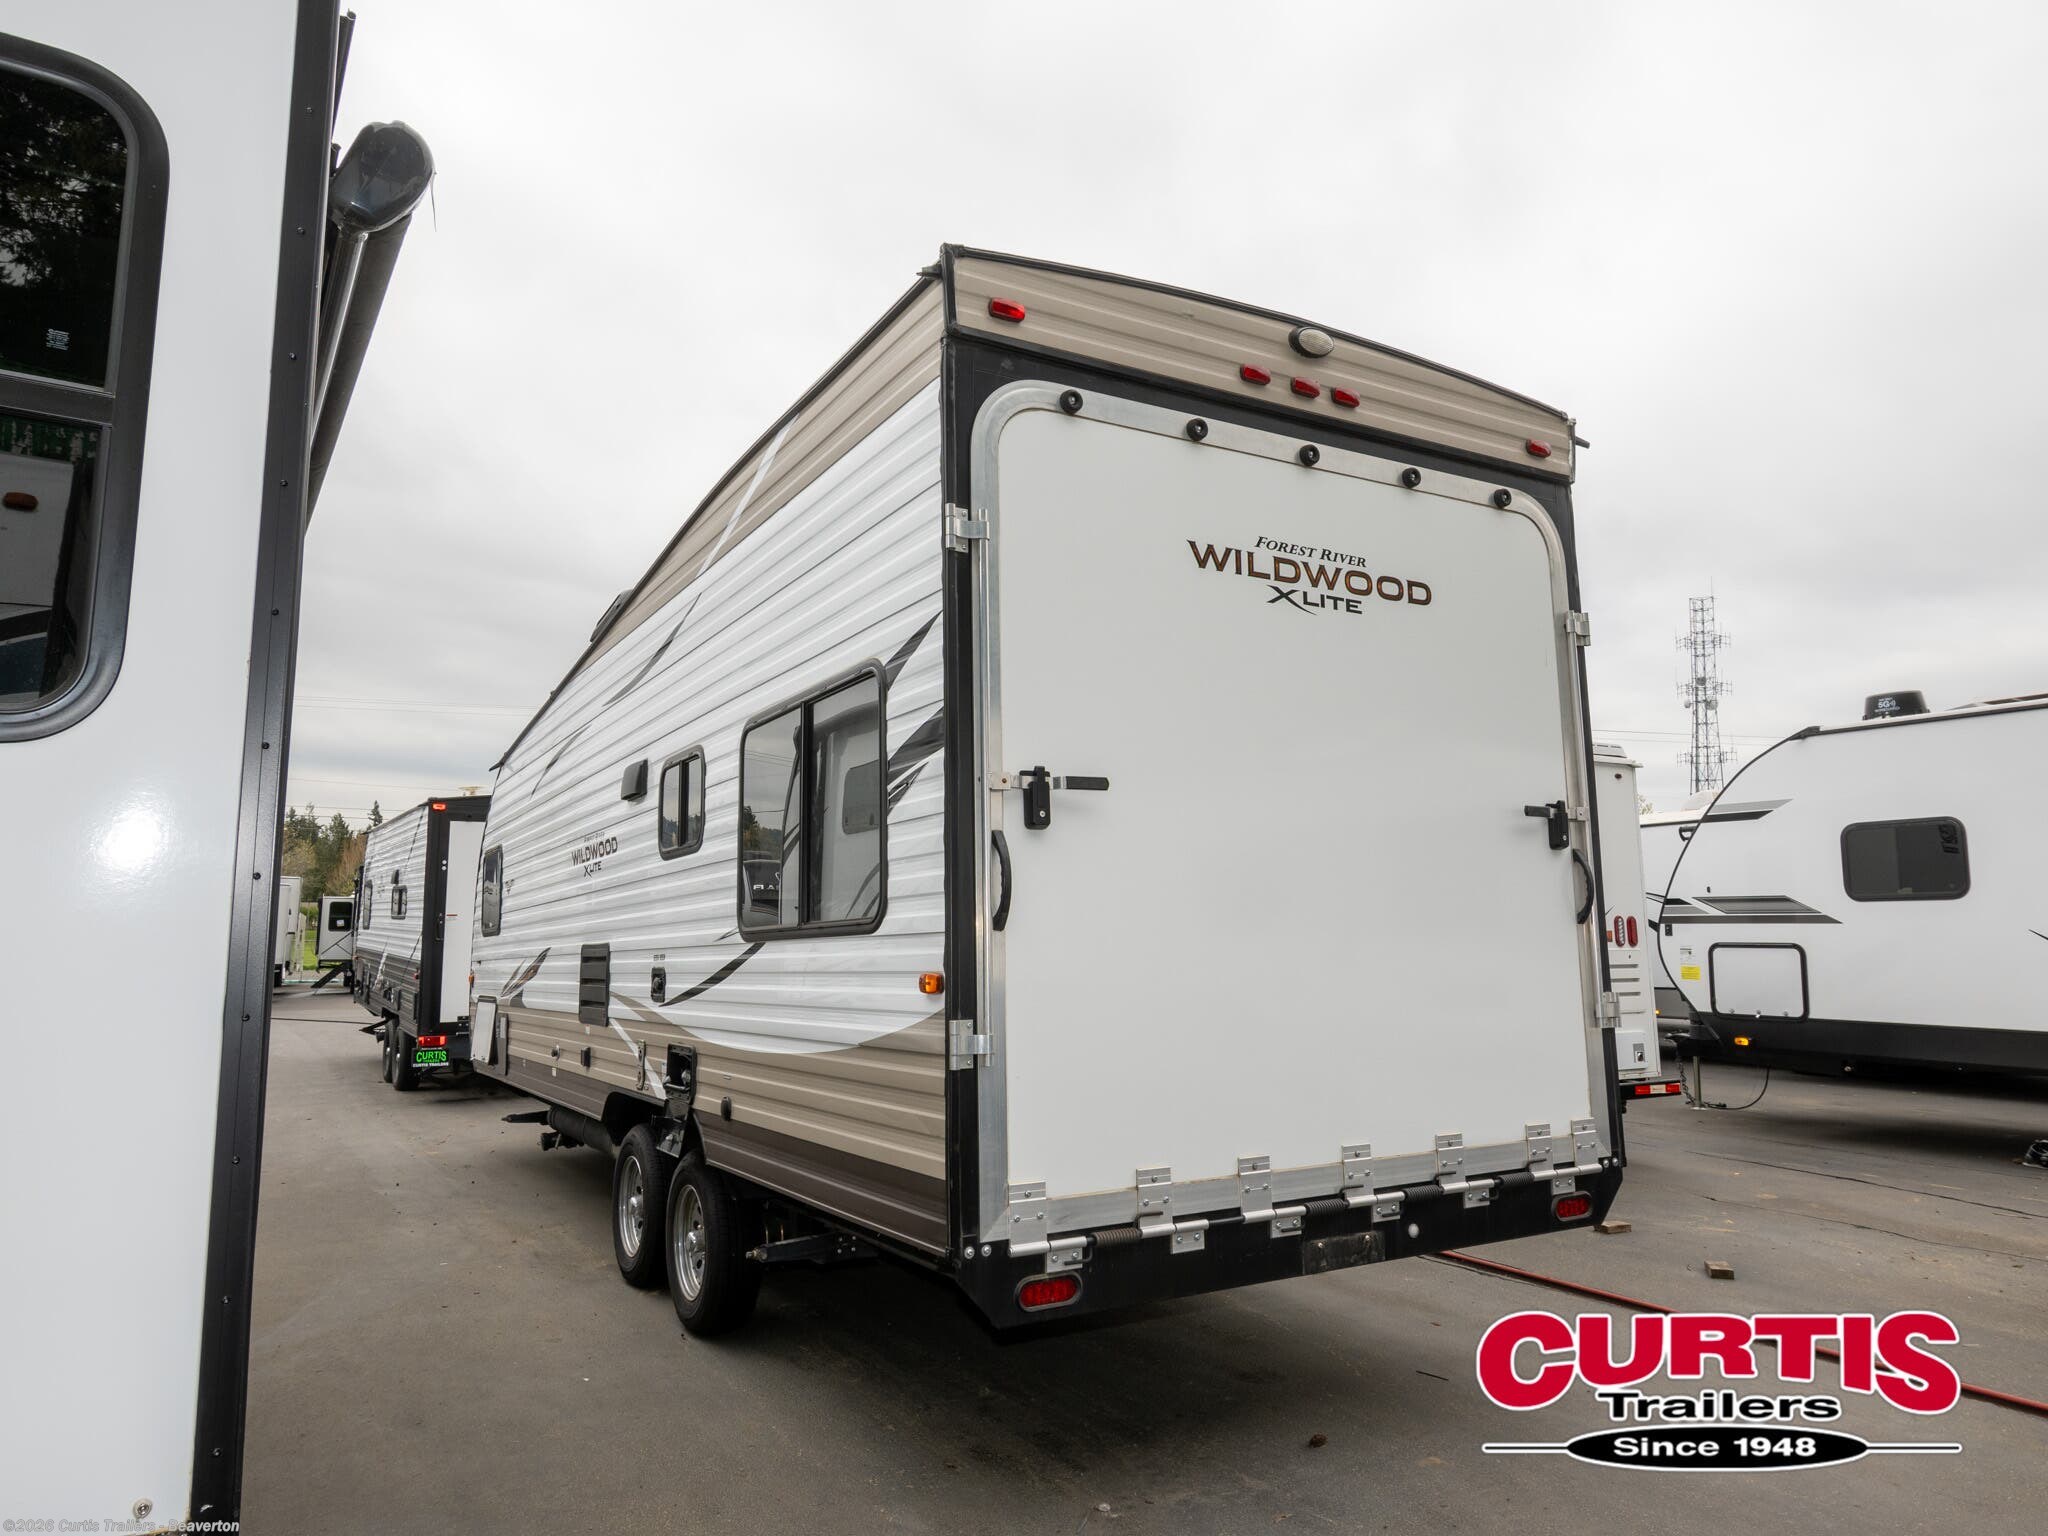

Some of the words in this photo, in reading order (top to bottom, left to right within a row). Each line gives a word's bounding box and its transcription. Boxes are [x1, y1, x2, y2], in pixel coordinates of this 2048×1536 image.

[1255, 536, 1317, 558] FOREST
[1320, 548, 1367, 568] RIVER
[1186, 539, 1432, 606] WILDWOOD
[571, 836, 618, 866] WILDWOOD
[416, 1050, 447, 1062] CURTIS
